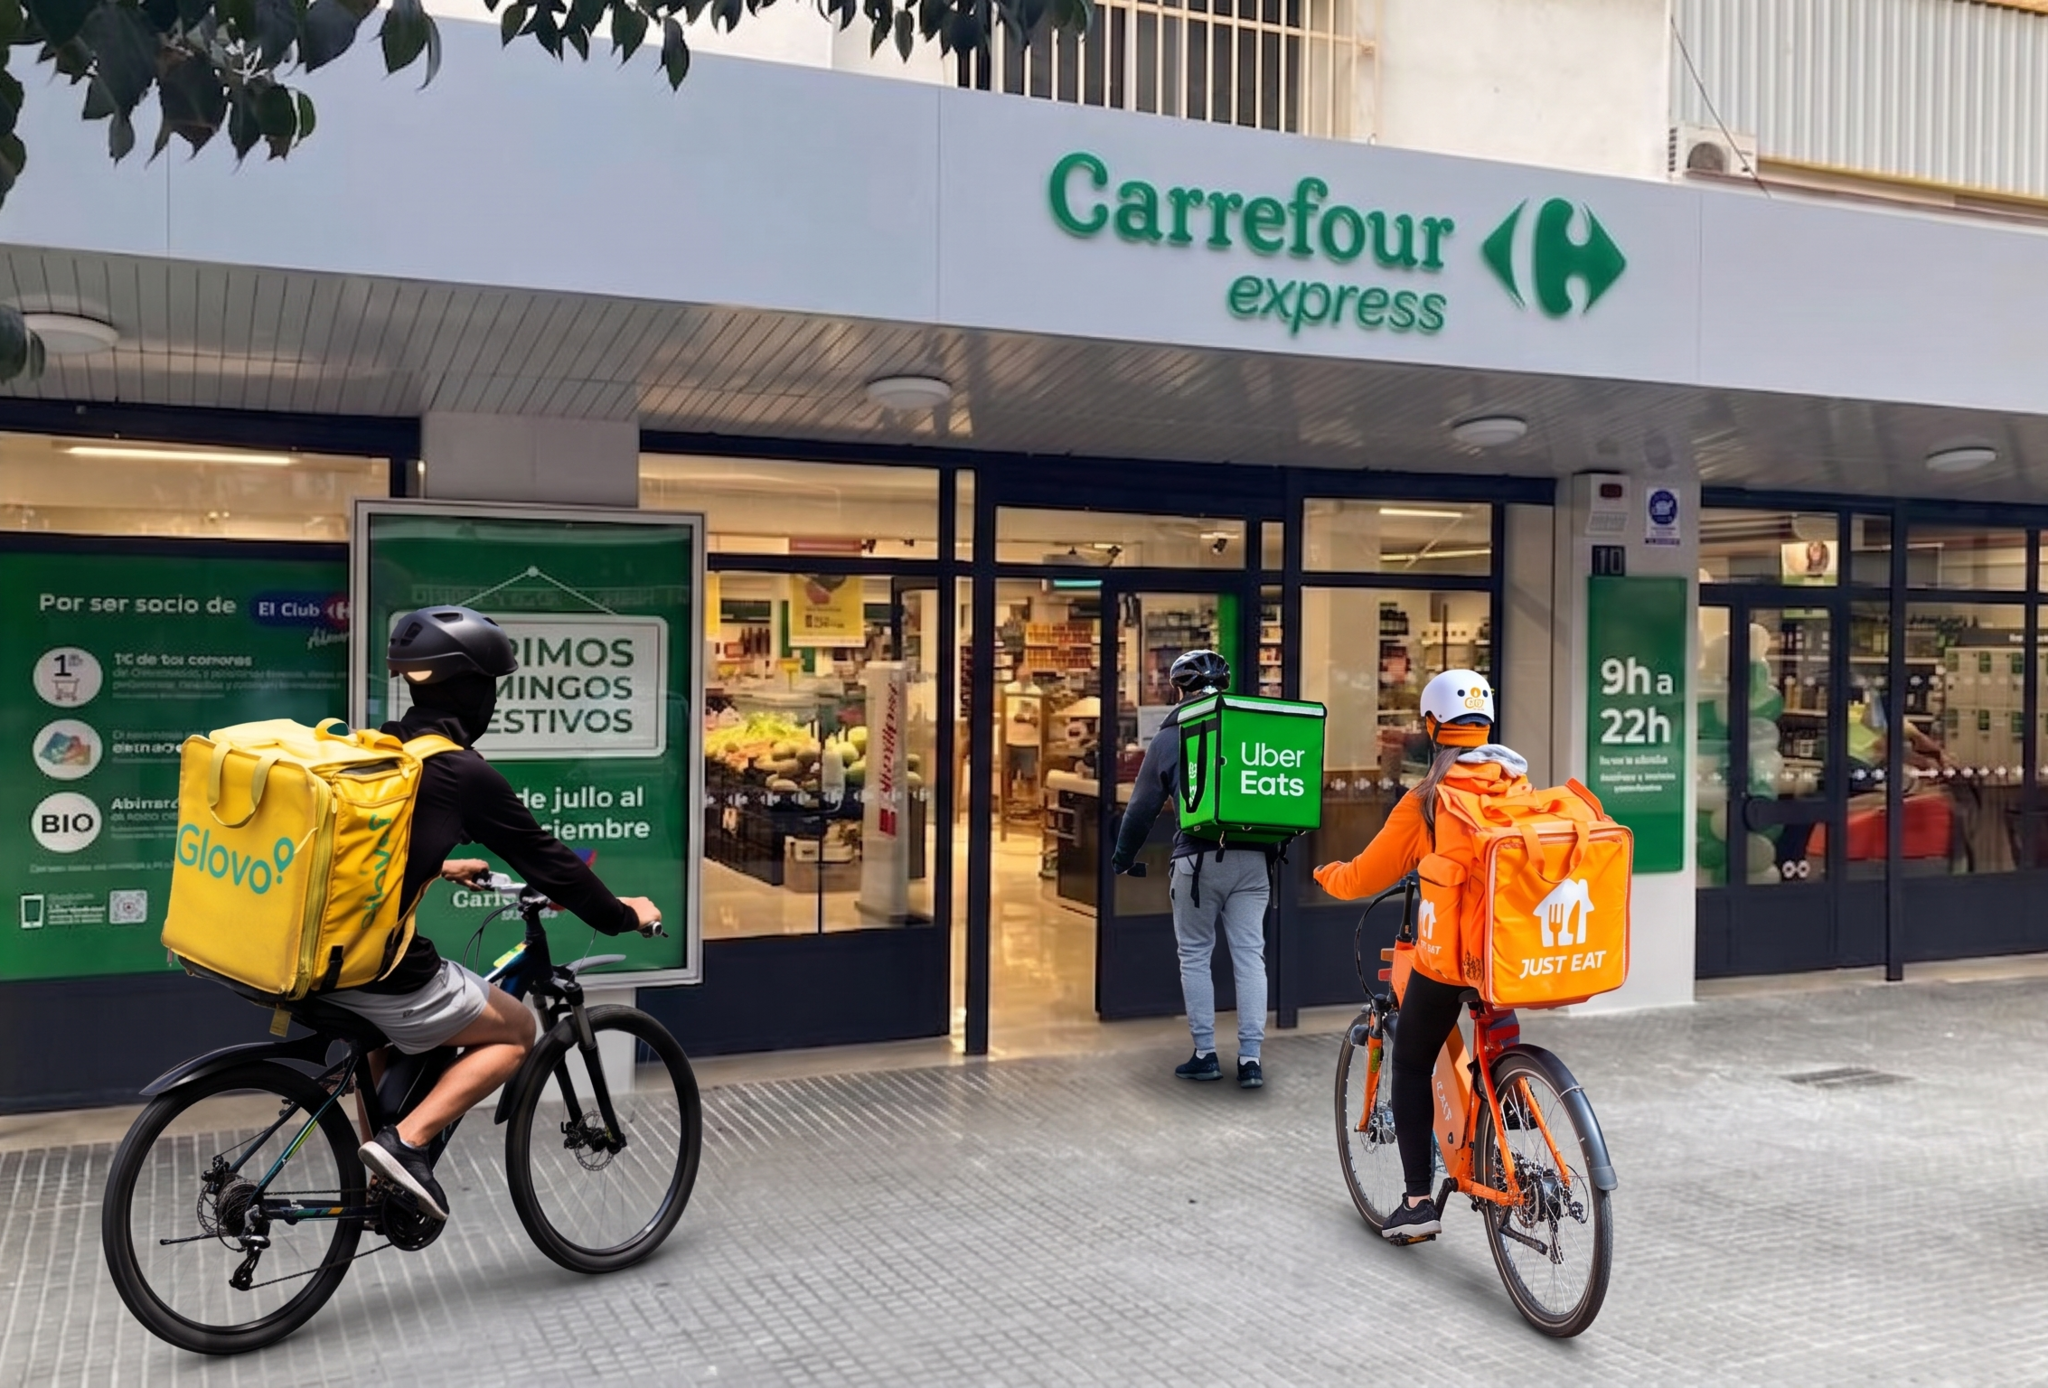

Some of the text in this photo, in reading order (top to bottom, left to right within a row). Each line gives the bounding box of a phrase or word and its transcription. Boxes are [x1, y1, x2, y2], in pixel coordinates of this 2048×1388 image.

[1049, 152, 1455, 271] Carrefour
[1227, 273, 1447, 337] express
[39, 593, 84, 611] Por
[90, 597, 129, 612] ser
[134, 594, 199, 613] socio
[206, 597, 237, 613] de
[281, 602, 320, 617] Club
[1601, 656, 1673, 695] 9h a
[1600, 706, 1671, 744] 22h
[1241, 741, 1305, 768] Uber
[620, 786, 643, 807] al
[1240, 769, 1305, 797] Eats
[41, 813, 94, 833] BIO
[177, 823, 272, 895] Glovo
[1519, 950, 1607, 980] JUST EAT
